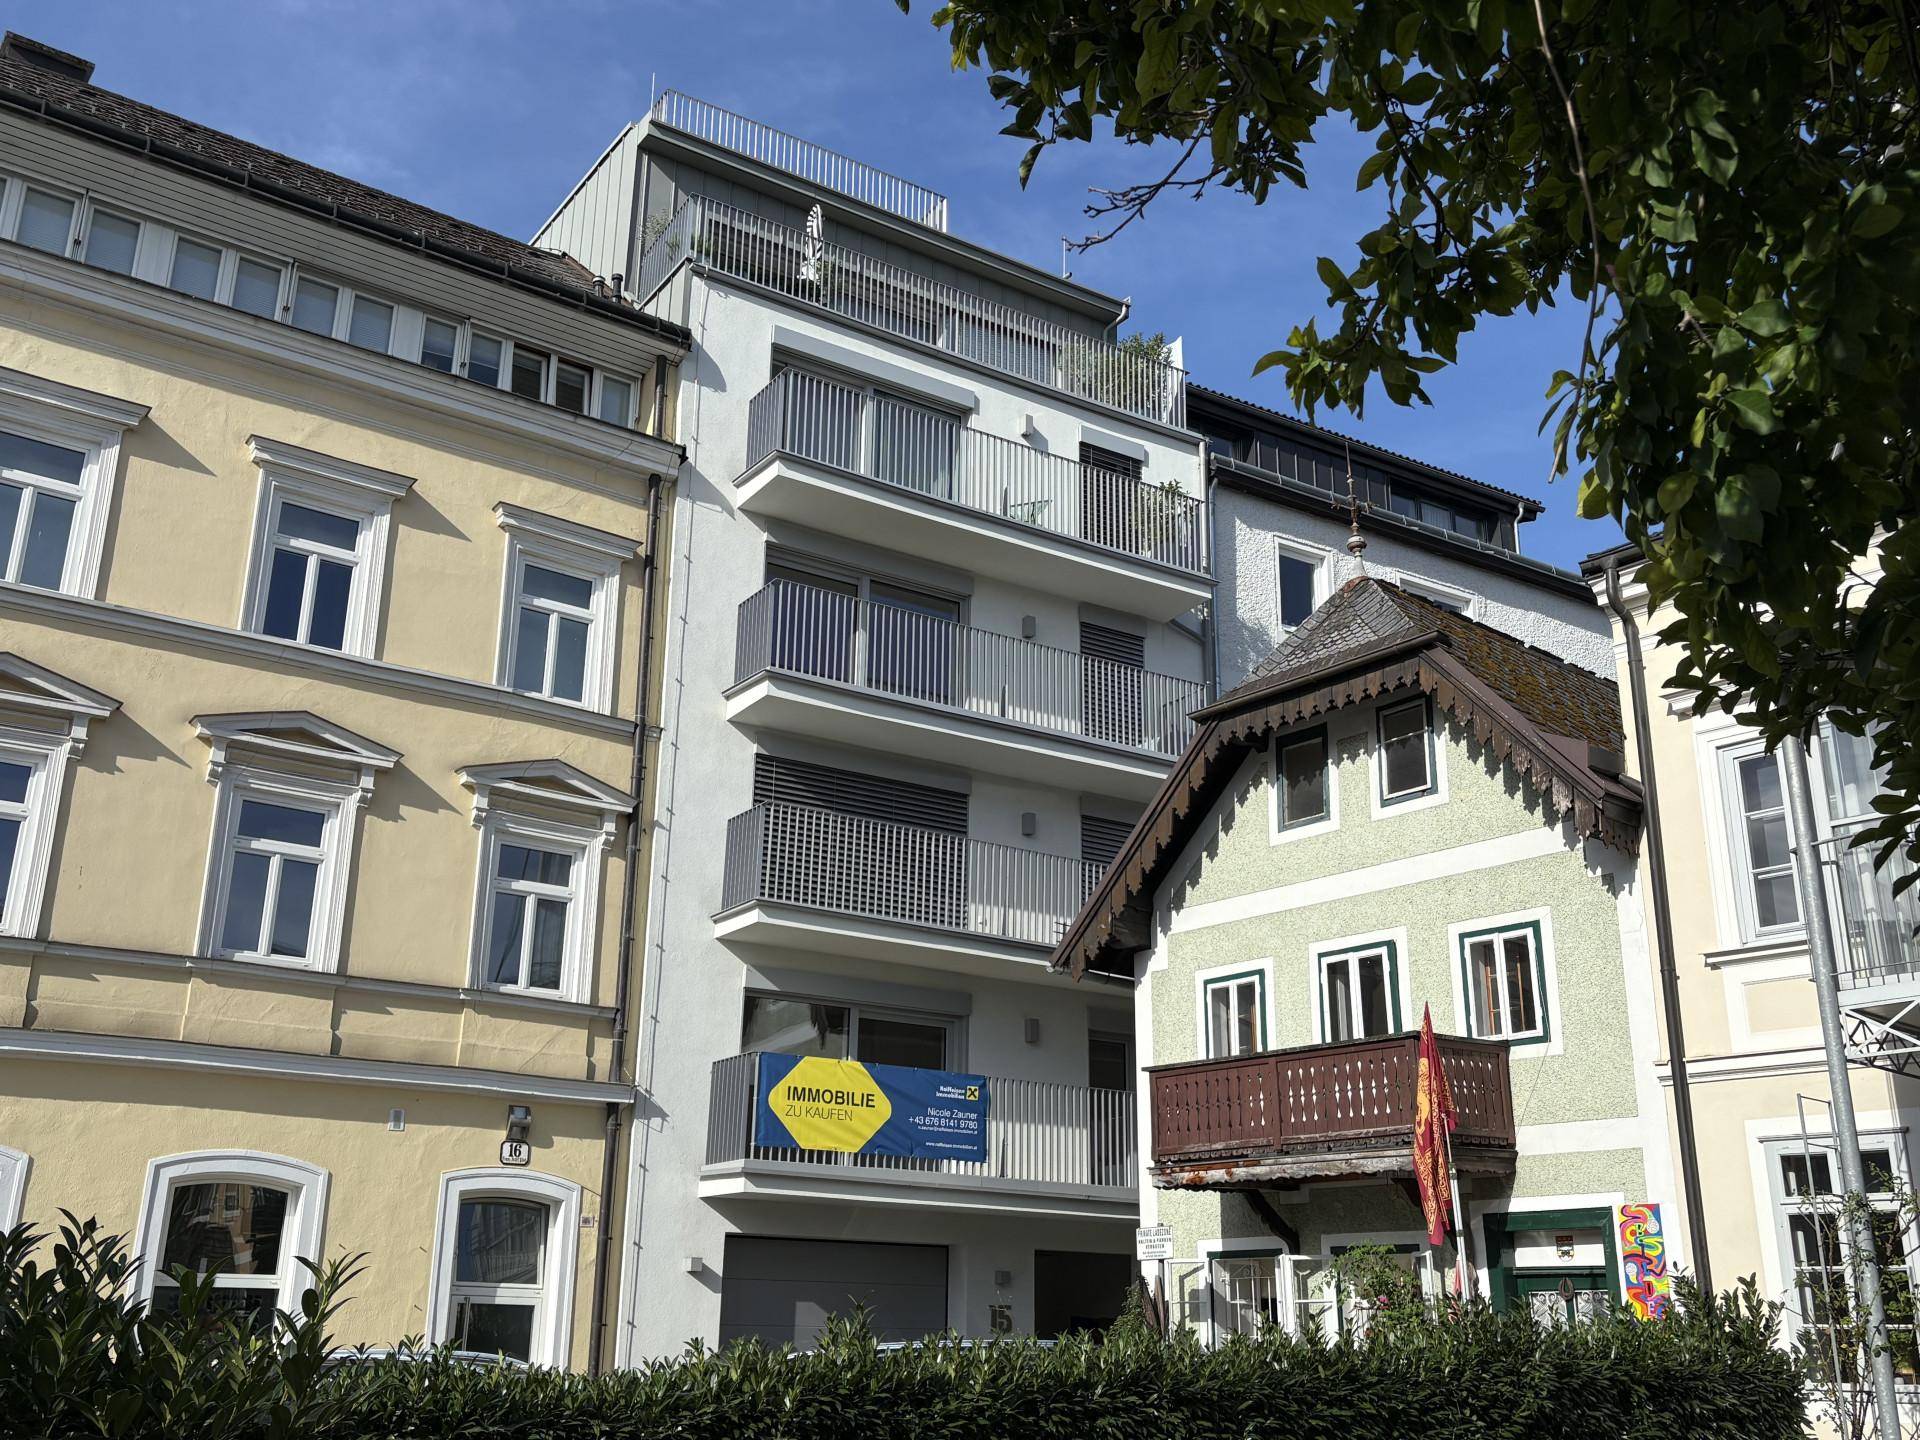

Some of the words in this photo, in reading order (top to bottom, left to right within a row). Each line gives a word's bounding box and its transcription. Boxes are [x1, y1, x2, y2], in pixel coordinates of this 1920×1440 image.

[787, 1086, 875, 1108] IMMOBILIE
[785, 1105, 801, 1117] ZU
[805, 1107, 853, 1121] KAUFEN
[927, 1107, 951, 1117] Nicole
[952, 1110, 977, 1119] Zauner
[908, 1116, 924, 1125] +43
[925, 1117, 939, 1126] 676
[940, 1118, 958, 1127] 8141
[960, 1120, 978, 1129] 9780
[509, 1143, 522, 1158] 16
